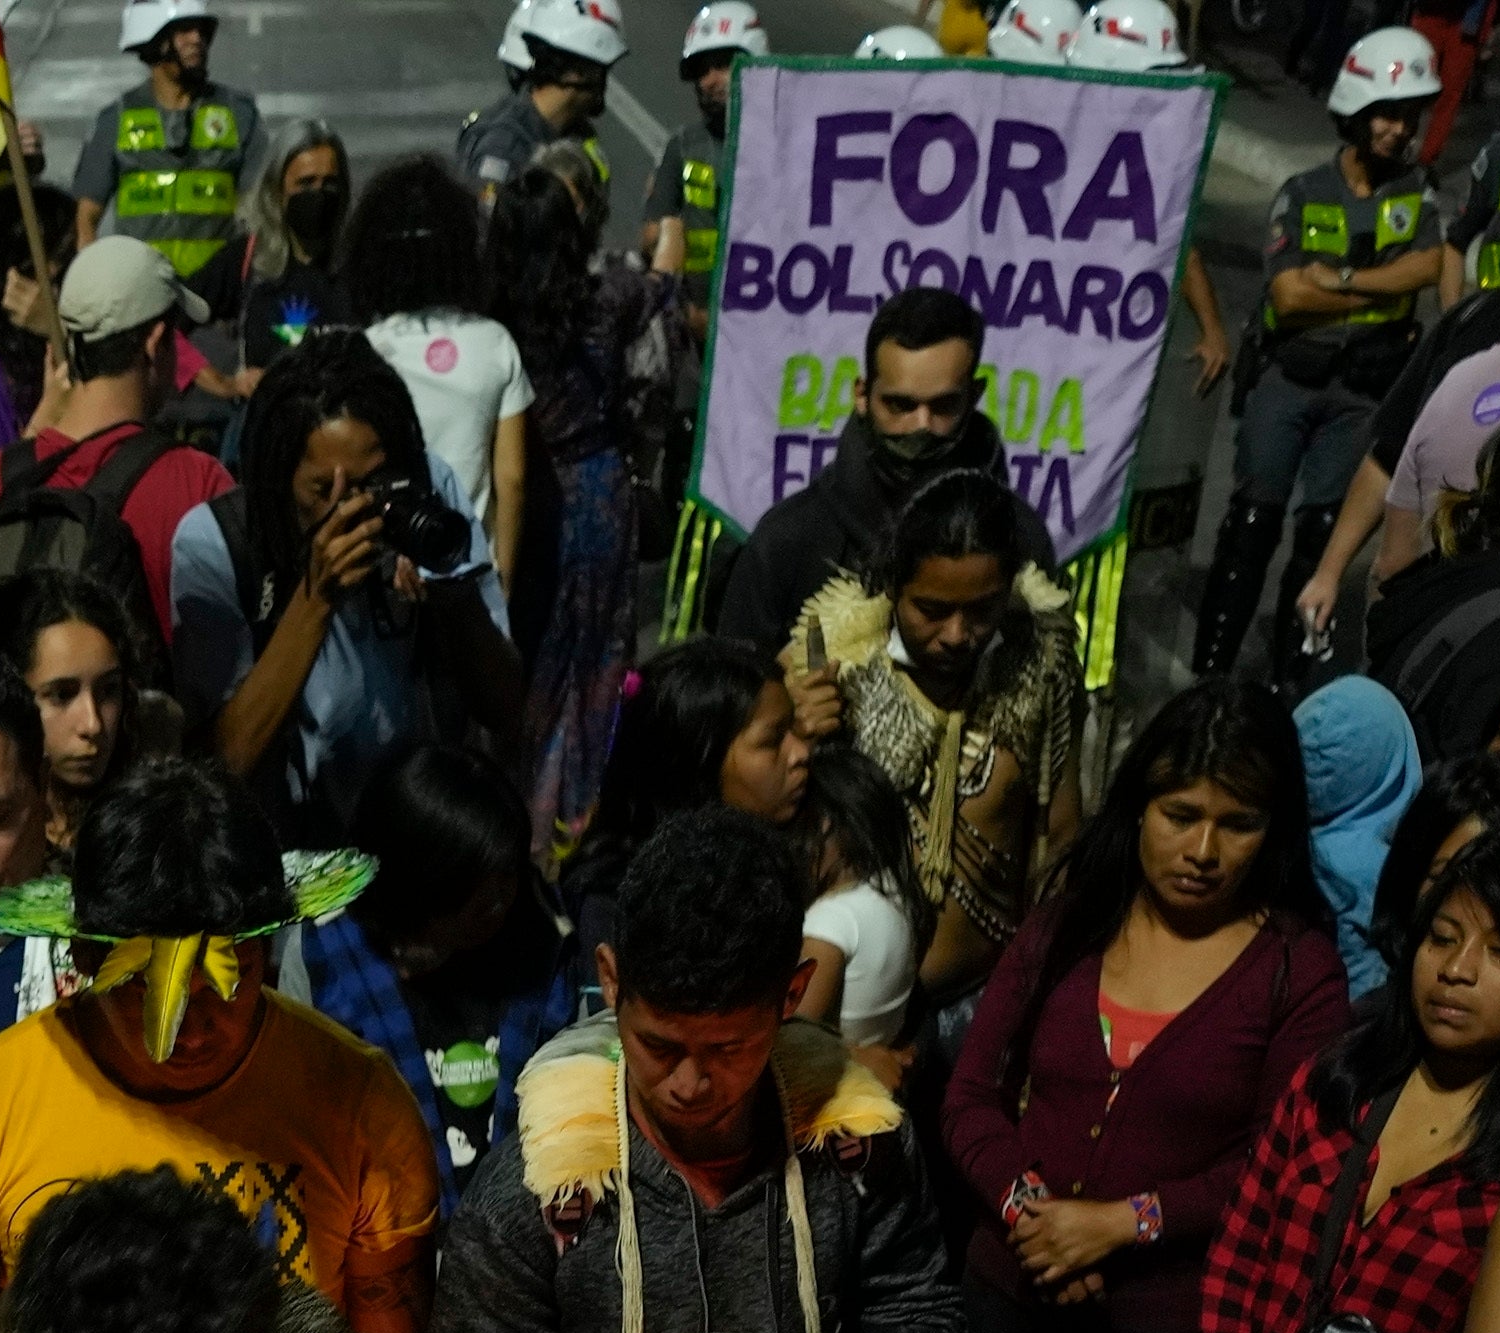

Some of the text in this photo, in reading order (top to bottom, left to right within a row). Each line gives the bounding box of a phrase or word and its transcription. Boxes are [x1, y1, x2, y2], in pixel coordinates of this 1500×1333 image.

[1162, 27, 1172, 50] P
[1390, 60, 1404, 84] P
[809, 111, 1158, 244] FORA
[721, 240, 1169, 343] BOLSONARO
